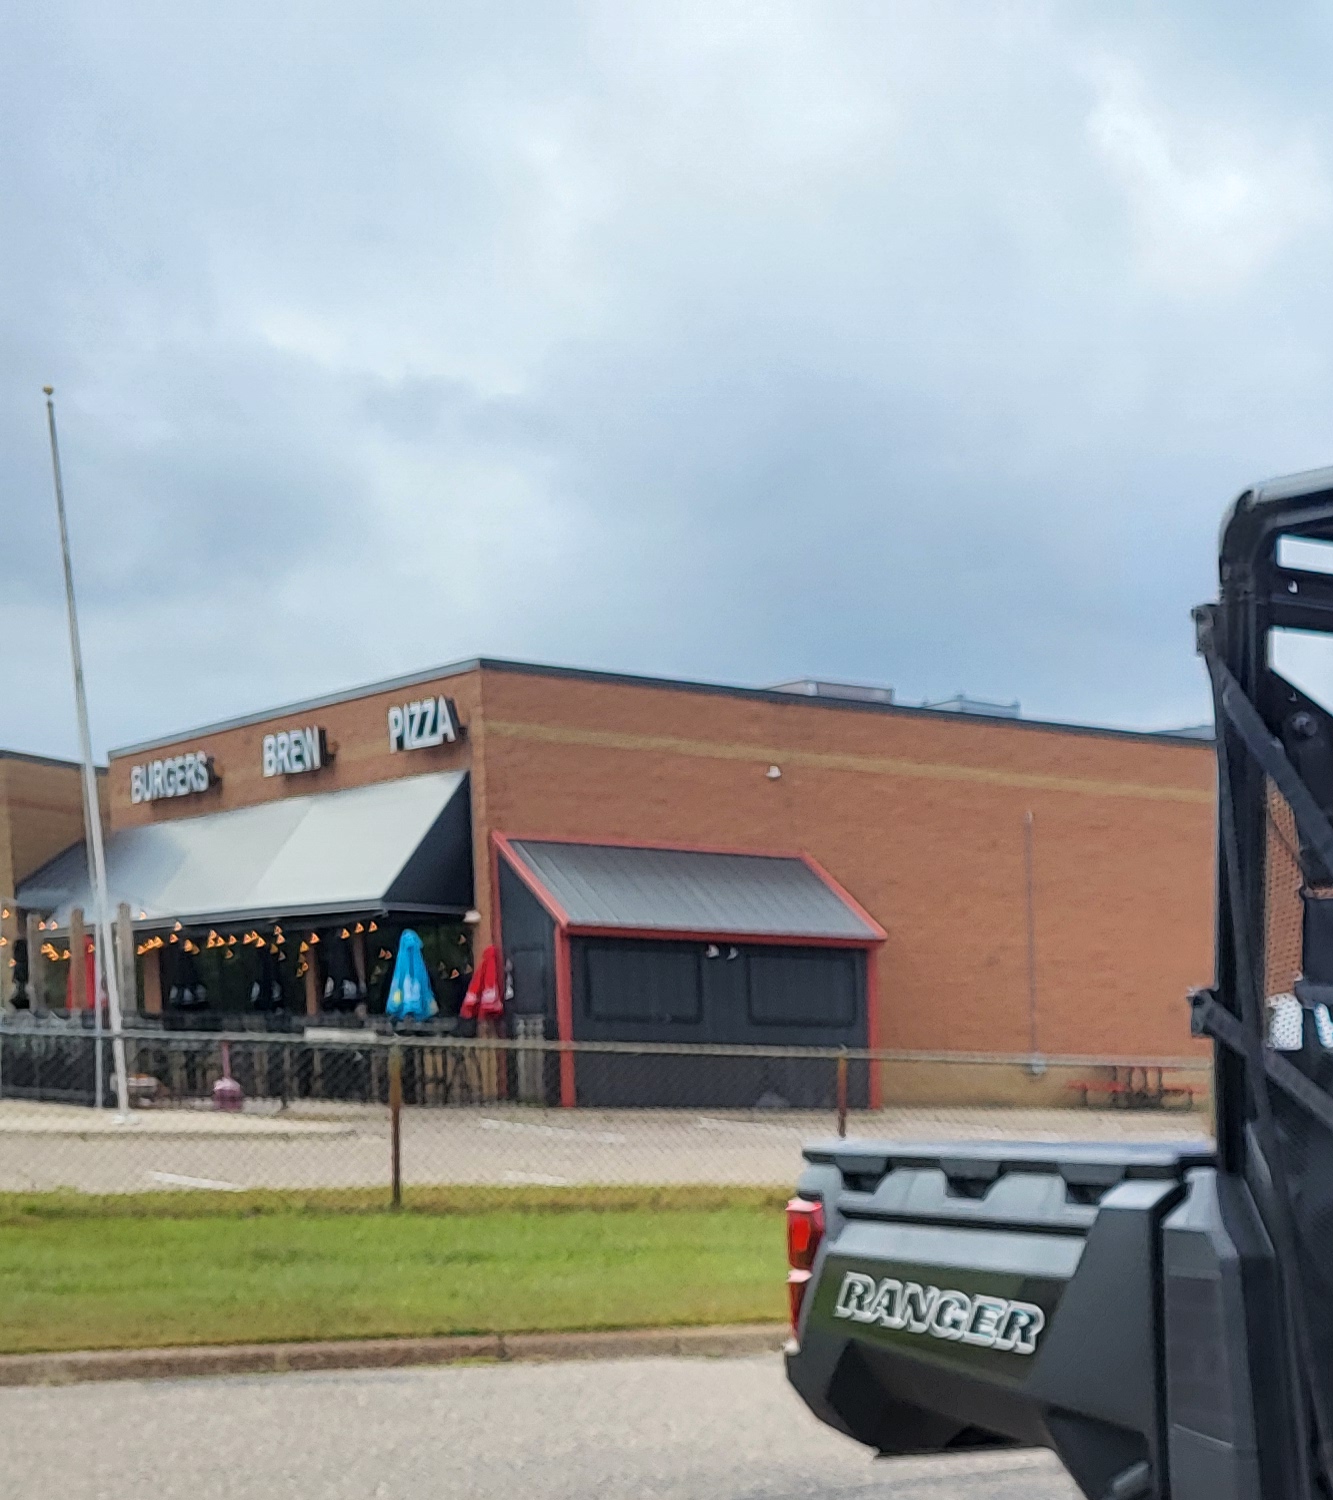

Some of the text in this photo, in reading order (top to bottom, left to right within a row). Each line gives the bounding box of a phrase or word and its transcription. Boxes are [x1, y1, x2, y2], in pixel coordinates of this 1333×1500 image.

[130, 694, 457, 805] BURGERS BREW PIZZA
[834, 1271, 1045, 1355] RANGER
